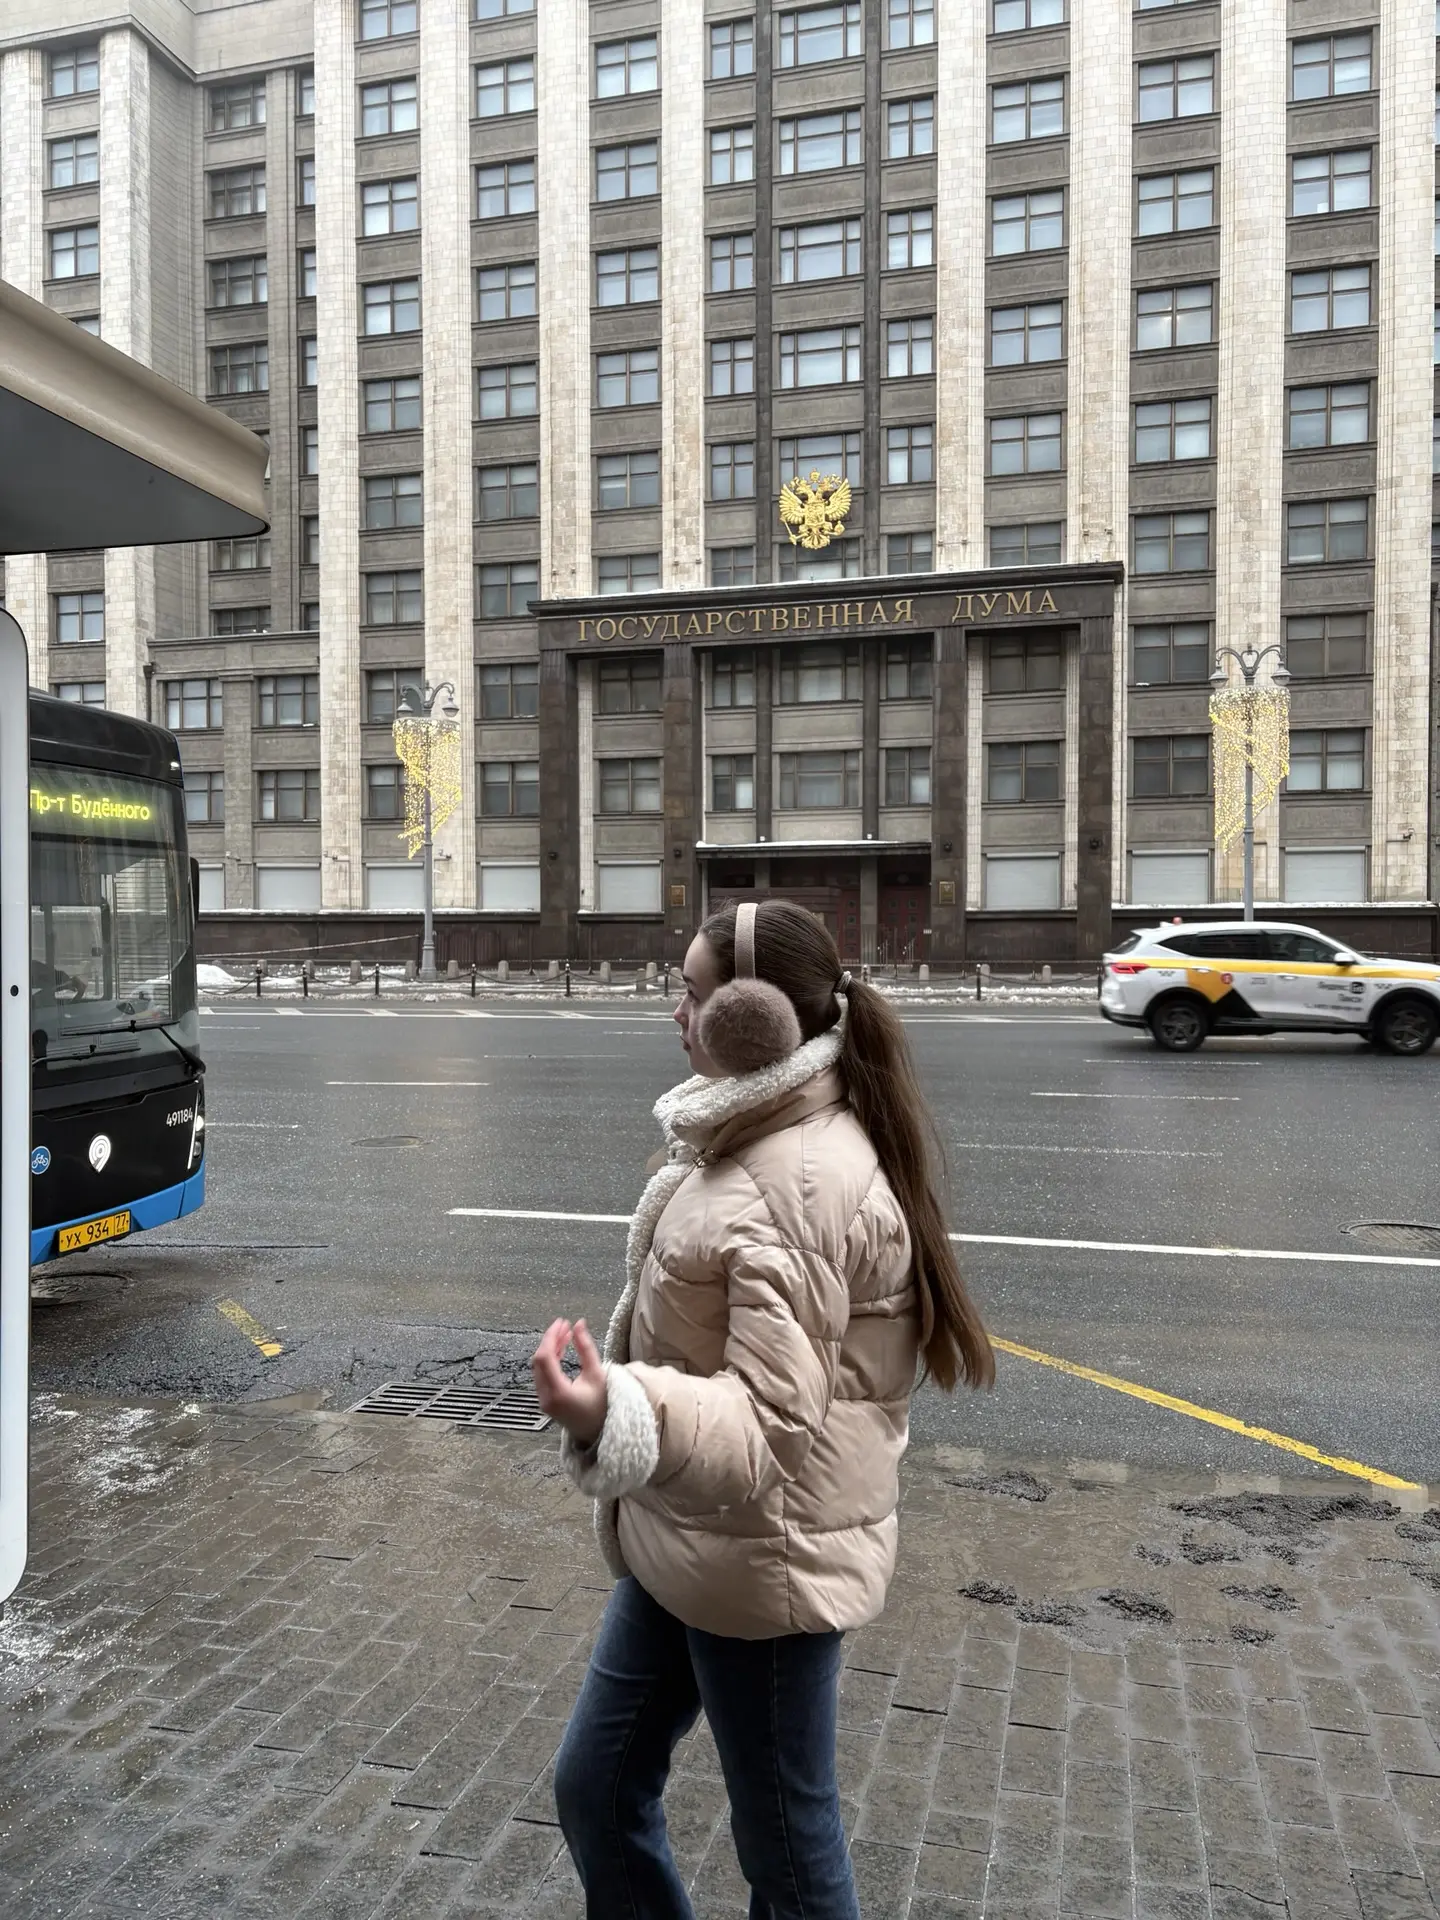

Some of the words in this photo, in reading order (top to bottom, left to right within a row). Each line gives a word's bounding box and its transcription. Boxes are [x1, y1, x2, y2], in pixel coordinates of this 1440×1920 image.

[577, 599, 914, 642] ГОСУДАРСТВЕННАЯ
[952, 589, 1059, 623] ДУМА
[30, 789, 66, 815] Пр-т
[71, 793, 151, 820] Будённого
[166, 1107, 193, 1127] 491184
[87, 1220, 109, 1242] 934
[115, 1213, 126, 1229] 77
